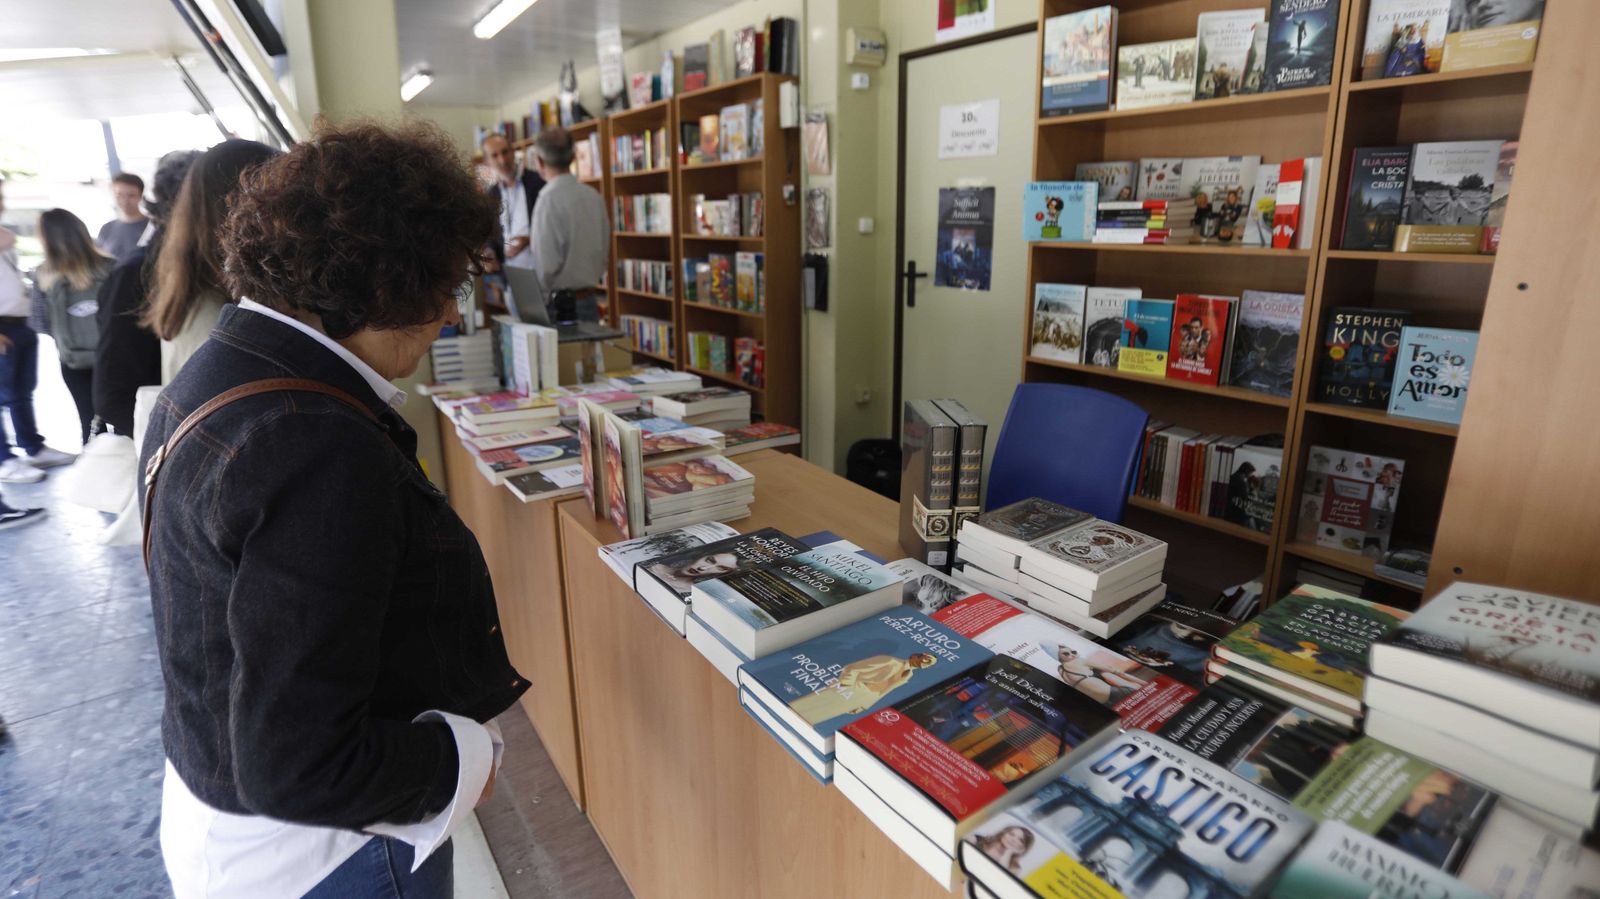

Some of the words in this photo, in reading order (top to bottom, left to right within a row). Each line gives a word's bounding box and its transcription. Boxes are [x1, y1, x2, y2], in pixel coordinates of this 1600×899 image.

[1361, 158, 1381, 167] ELIA
[1383, 157, 1408, 166] BARC
[1371, 166, 1385, 175] LA
[1073, 183, 1083, 191] de
[1371, 181, 1405, 190] CRISTA
[1335, 313, 1404, 327] STEPHEN
[1332, 327, 1400, 348] KING
[1407, 343, 1466, 367] Todo
[1409, 365, 1439, 380] es
[1325, 384, 1390, 402] HOLLY
[1398, 379, 1468, 402] Amor
[746, 546, 775, 563] CONDES
[748, 535, 793, 560] MONFORT
[768, 537, 799, 555] REYES
[798, 564, 808, 573] EL
[809, 569, 836, 585] HIJO
[810, 552, 873, 585] SANTIAGO
[832, 552, 874, 573] MIKEL
[781, 565, 831, 593] OLVIDADO
[1312, 603, 1388, 630] GABRIEL
[1455, 594, 1600, 628] CASTILL
[879, 614, 960, 663] PÉREZ-REVERTE
[899, 614, 962, 651] ARTURO
[1283, 625, 1312, 637] NOS
[1315, 635, 1363, 654] VEMOS
[1289, 621, 1306, 629] EN
[1310, 628, 1367, 649] AGOSTO
[790, 668, 821, 696] FINAL
[792, 653, 853, 701] PROBLEMA
[827, 663, 842, 677] EL
[984, 673, 998, 687] Un
[998, 682, 1029, 701] animal
[1029, 697, 1058, 719] salvaje
[991, 667, 1015, 684] Joël
[1014, 679, 1056, 703] Dicker
[1168, 720, 1192, 742] Haruki
[1189, 699, 1217, 722] Murakami
[1185, 737, 1201, 752] LA
[1197, 712, 1229, 741] CIUDAD
[1230, 697, 1245, 711] SUS
[1199, 730, 1230, 758] MUROS
[1225, 701, 1263, 733] INCIERTOS
[1131, 735, 1188, 768] CARME
[1192, 766, 1289, 823] CHAPARRO
[1089, 742, 1280, 865] CASTIGO
